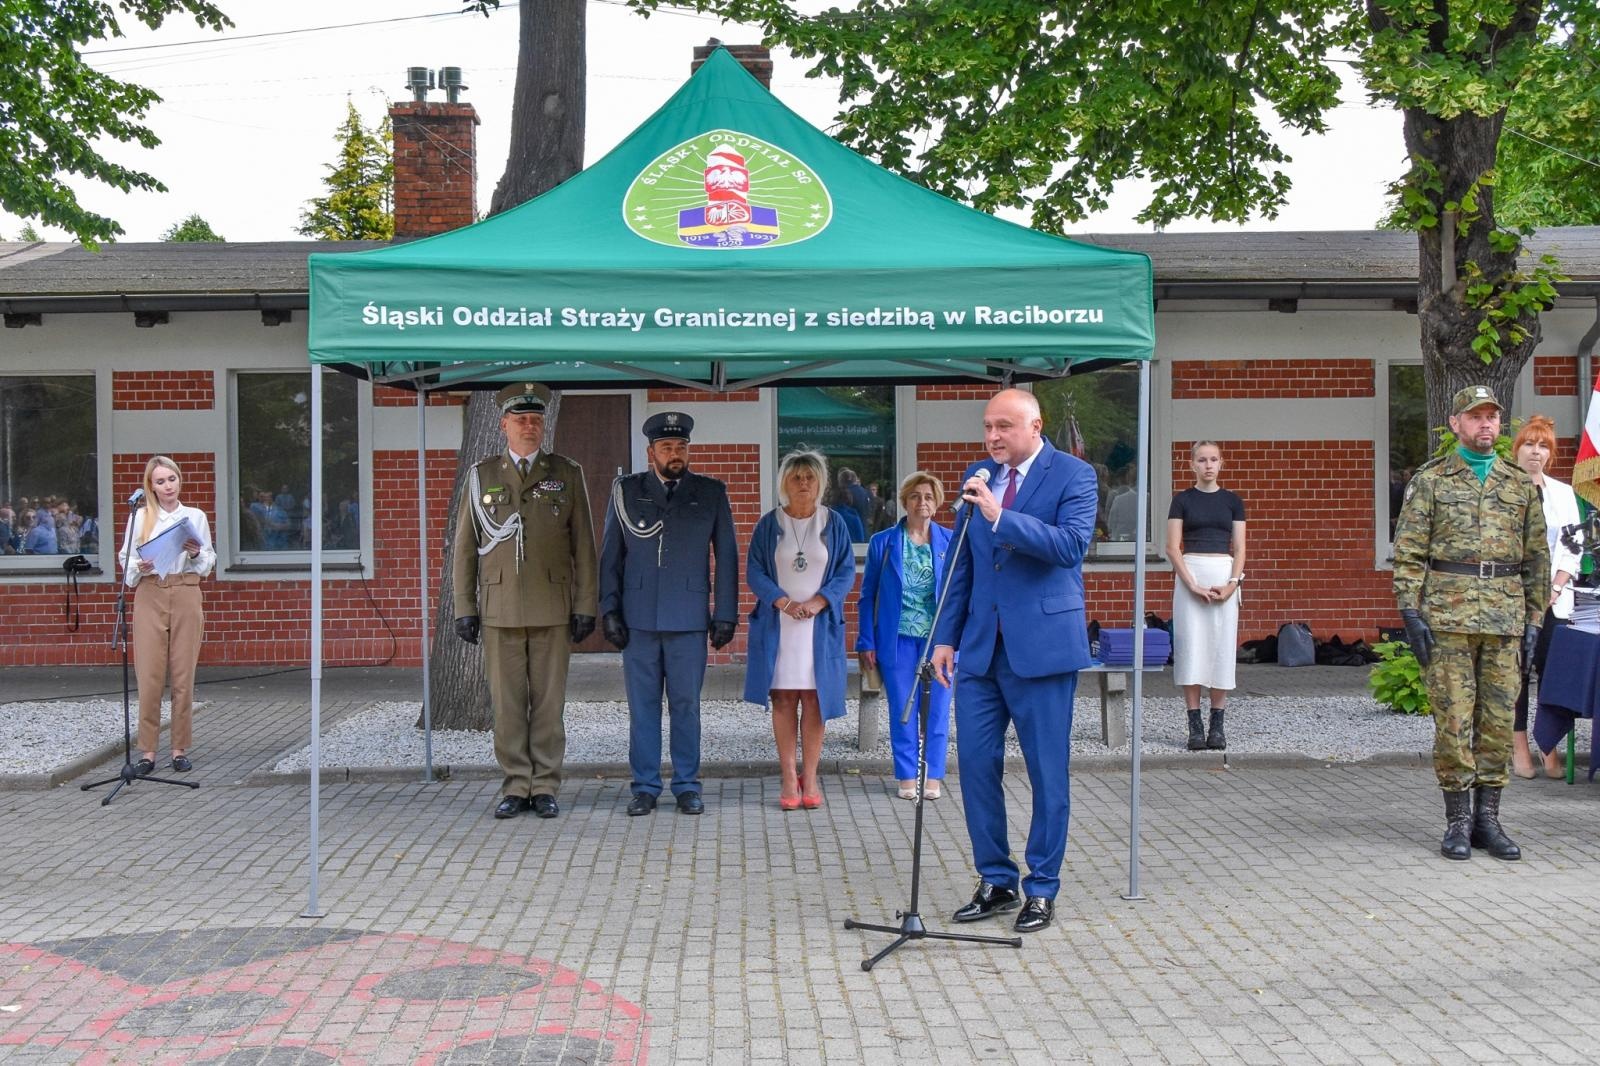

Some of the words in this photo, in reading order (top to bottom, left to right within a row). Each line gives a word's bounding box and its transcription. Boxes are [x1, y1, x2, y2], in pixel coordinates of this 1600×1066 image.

[709, 134, 791, 168] ODDZIAŁ
[791, 170, 812, 184] SG
[362, 301, 444, 330] Śląski
[453, 306, 552, 326] Oddział
[562, 307, 646, 332] Straży
[655, 307, 796, 332] Granicznej
[804, 312, 818, 326] z
[827, 306, 935, 331] siedzibą
[943, 312, 966, 326] w
[974, 305, 1104, 326] Raciborzu
